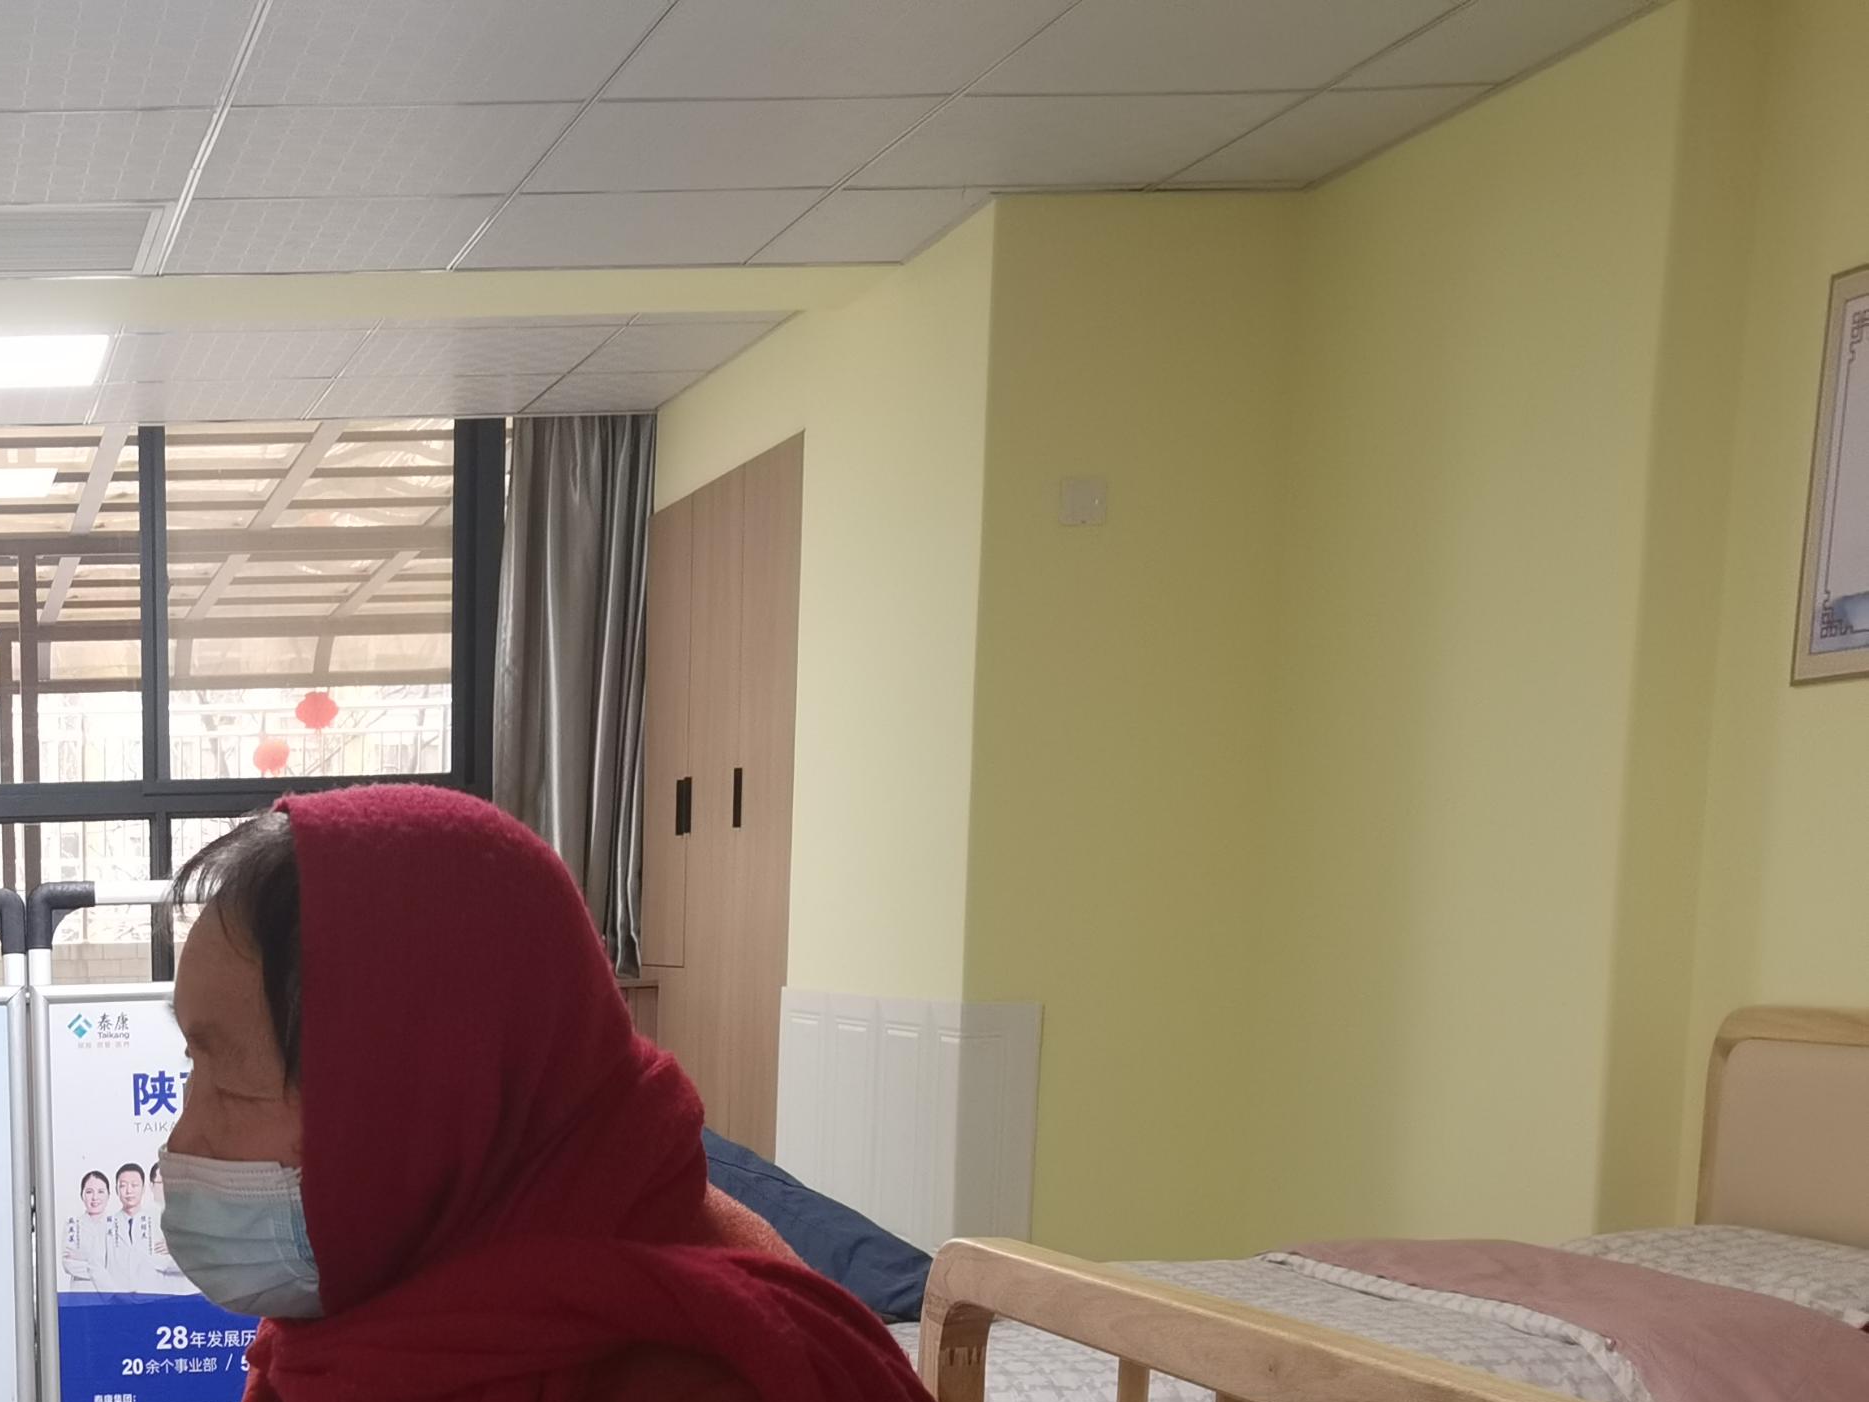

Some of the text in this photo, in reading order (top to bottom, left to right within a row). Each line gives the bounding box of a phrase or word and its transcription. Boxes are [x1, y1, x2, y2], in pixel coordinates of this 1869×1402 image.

[98, 1012, 129, 1031] 泰康
[122, 1357, 217, 1375] 20余个事业部
